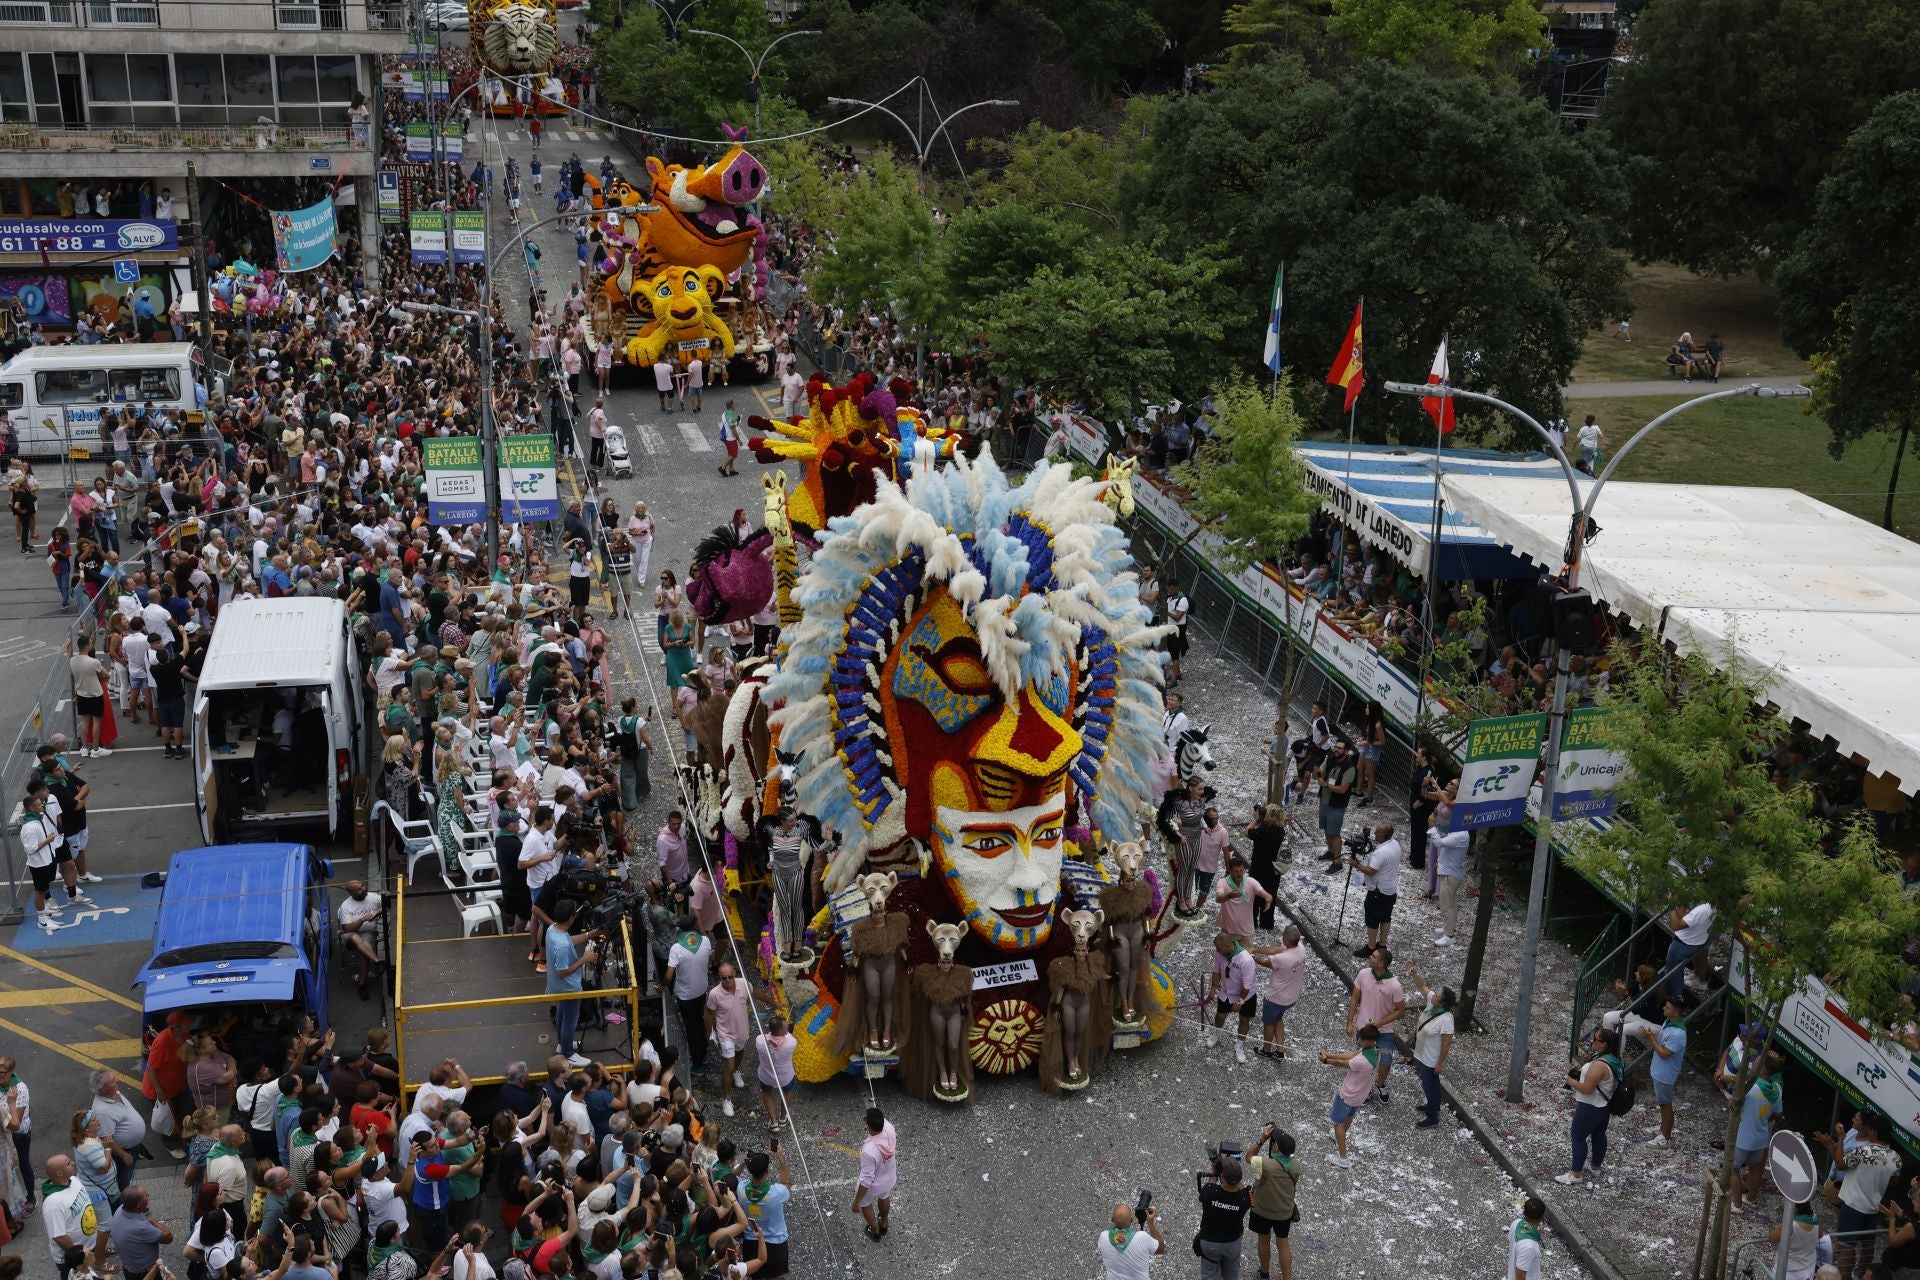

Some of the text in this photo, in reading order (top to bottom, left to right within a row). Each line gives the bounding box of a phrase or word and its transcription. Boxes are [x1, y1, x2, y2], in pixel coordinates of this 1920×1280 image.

[382, 175, 392, 188] L
[57, 236, 83, 250] 88
[428, 447, 477, 458] BATALLA
[502, 445, 550, 457] BATALLA
[429, 456, 478, 466] DE FLORES
[502, 454, 550, 464] DE FLORES
[1370, 510, 1412, 556] LAREDO
[1475, 720, 1540, 734] SEMANA GRANDE
[1473, 728, 1537, 746] BATALLA
[1567, 735, 1582, 745] DE
[1472, 739, 1536, 757] DE FLORES
[1580, 764, 1623, 777] Unicaja
[1472, 774, 1509, 796] FCC
[1474, 810, 1512, 823] LAREDO
[973, 968, 996, 978] UNA
[1010, 963, 1030, 972] MIL
[985, 973, 1022, 985] VECES
[1801, 1011, 1824, 1033] AEDAS
[1800, 1019, 1823, 1041] HOMES
[1776, 1027, 1795, 1048] SEMANA
[1795, 1041, 1814, 1063] GRANDE
[1816, 1061, 1836, 1082] BATALLA
[1857, 1062, 1879, 1089] FCC
